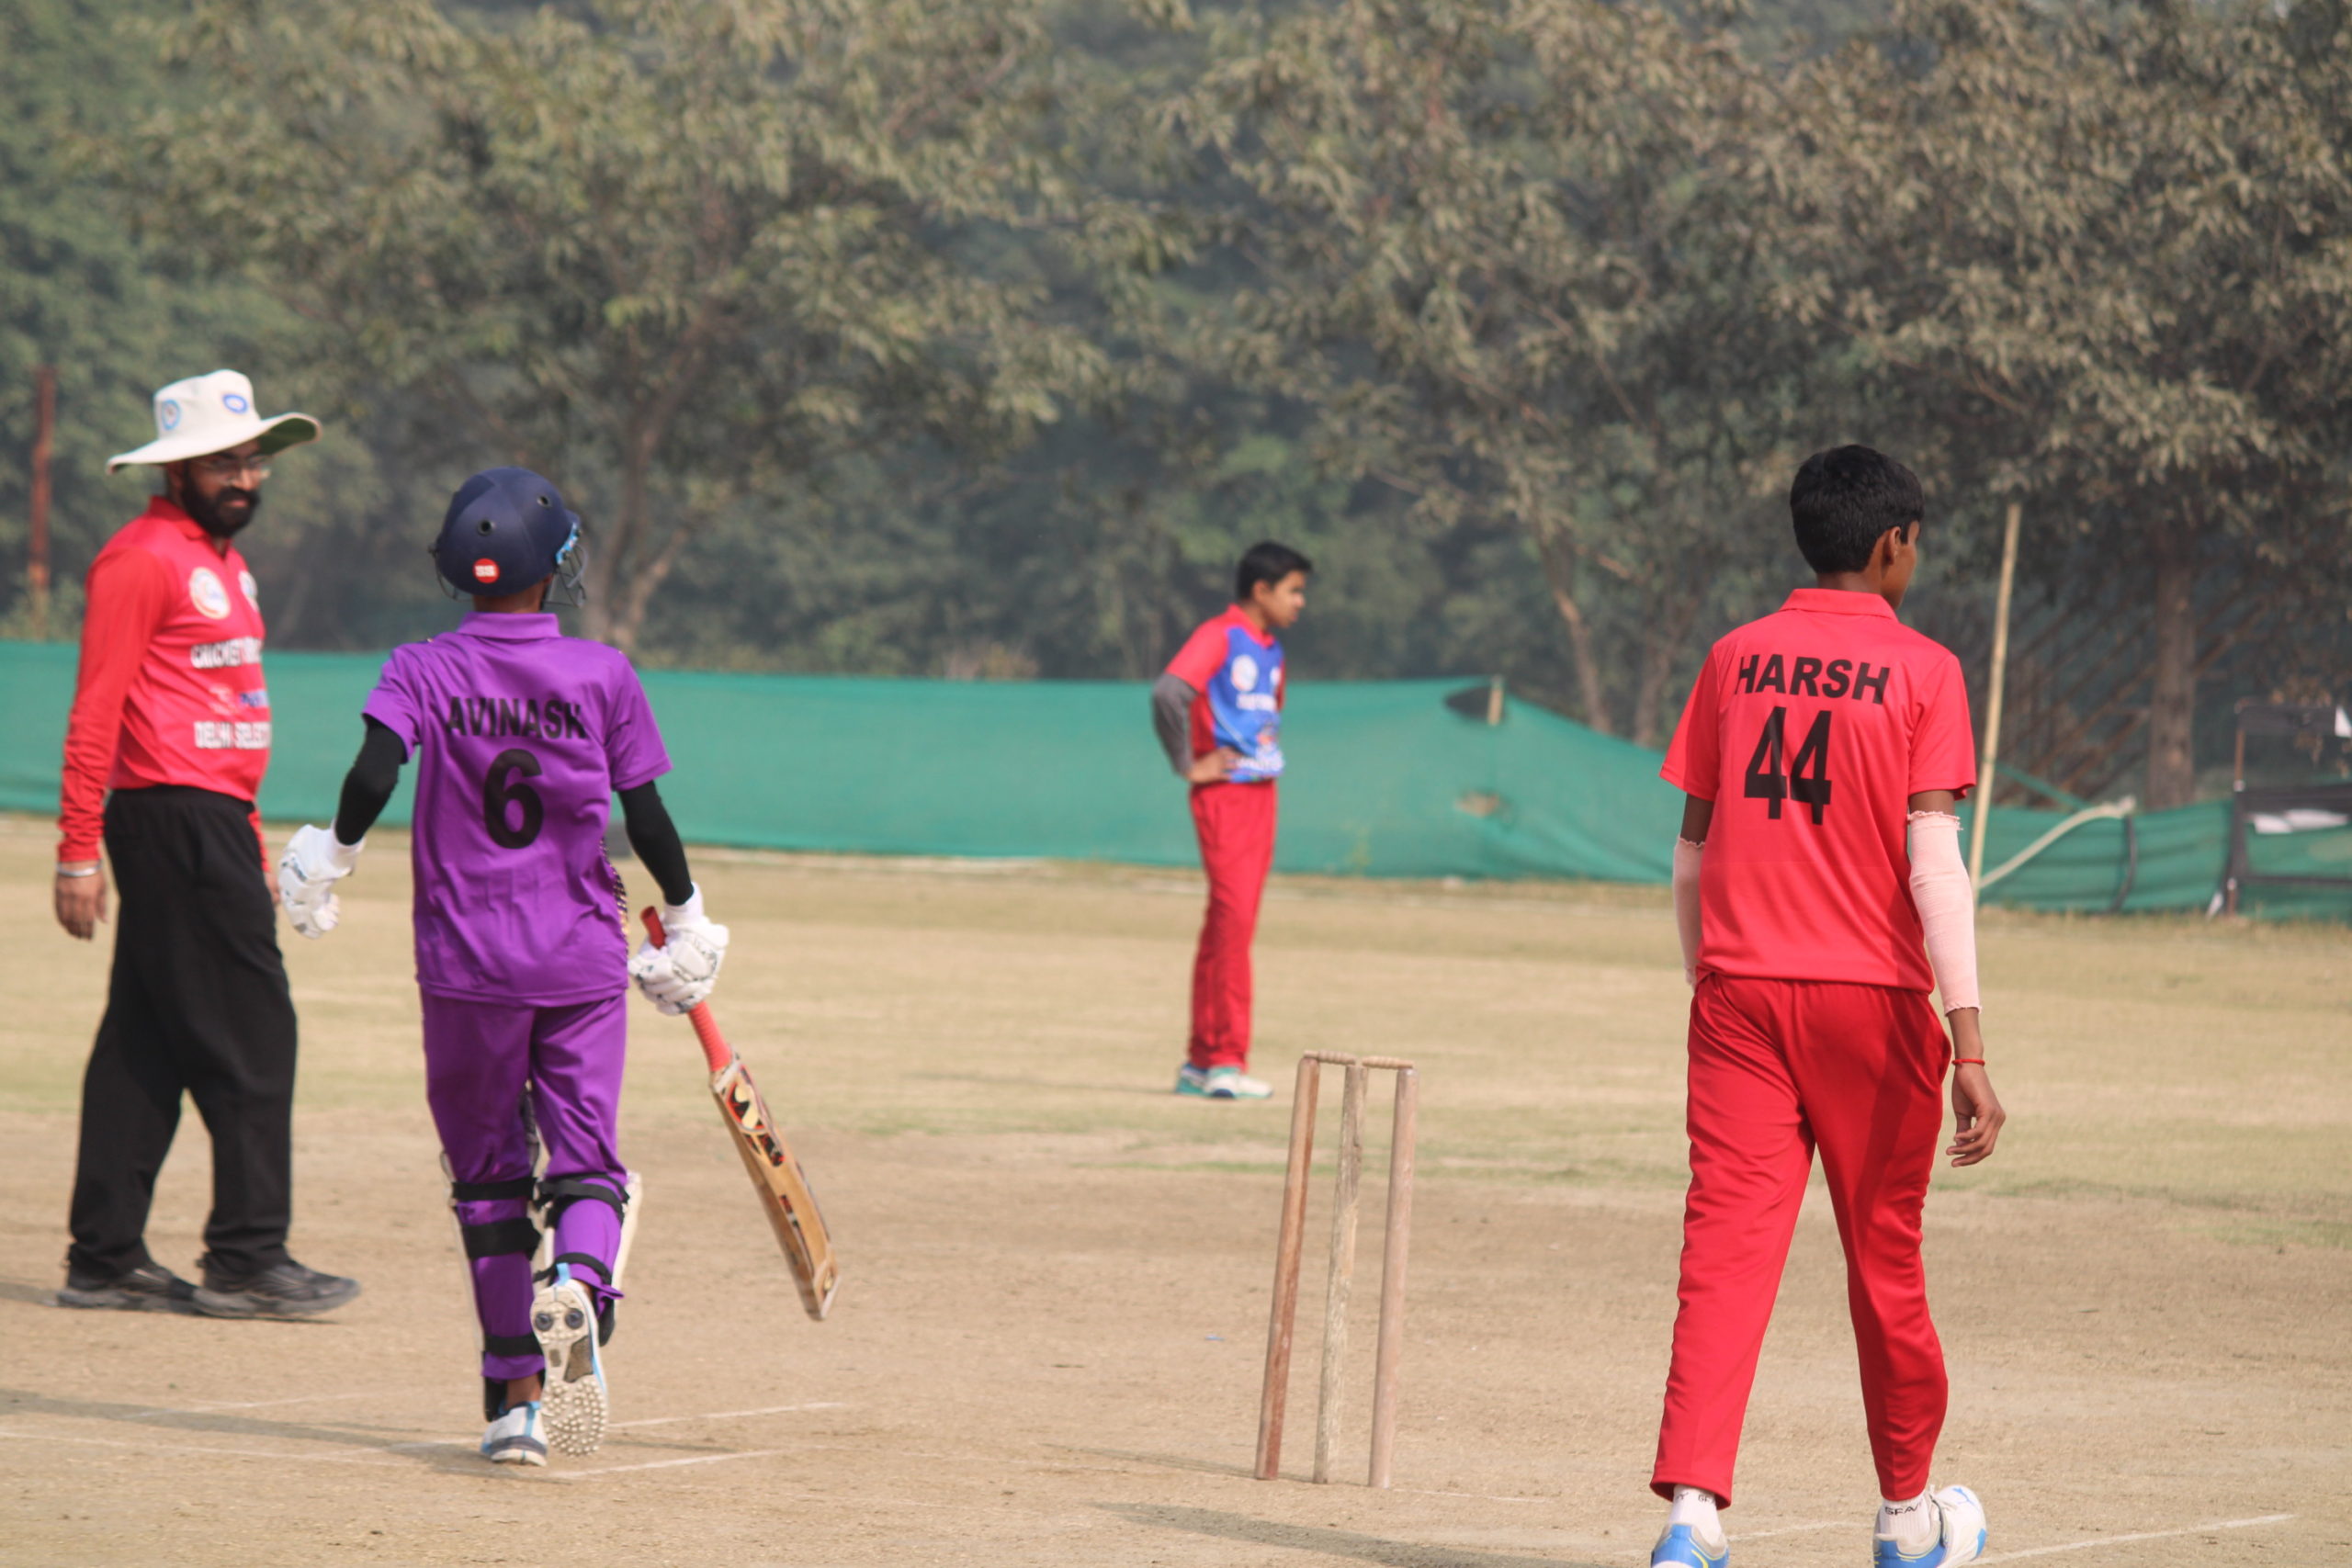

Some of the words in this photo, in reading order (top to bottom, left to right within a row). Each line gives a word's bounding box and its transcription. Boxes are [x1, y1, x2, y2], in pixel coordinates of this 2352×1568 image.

[1735, 653, 1890, 705] HARSH
[483, 748, 544, 850] 6
[1744, 705, 1833, 826] 44
